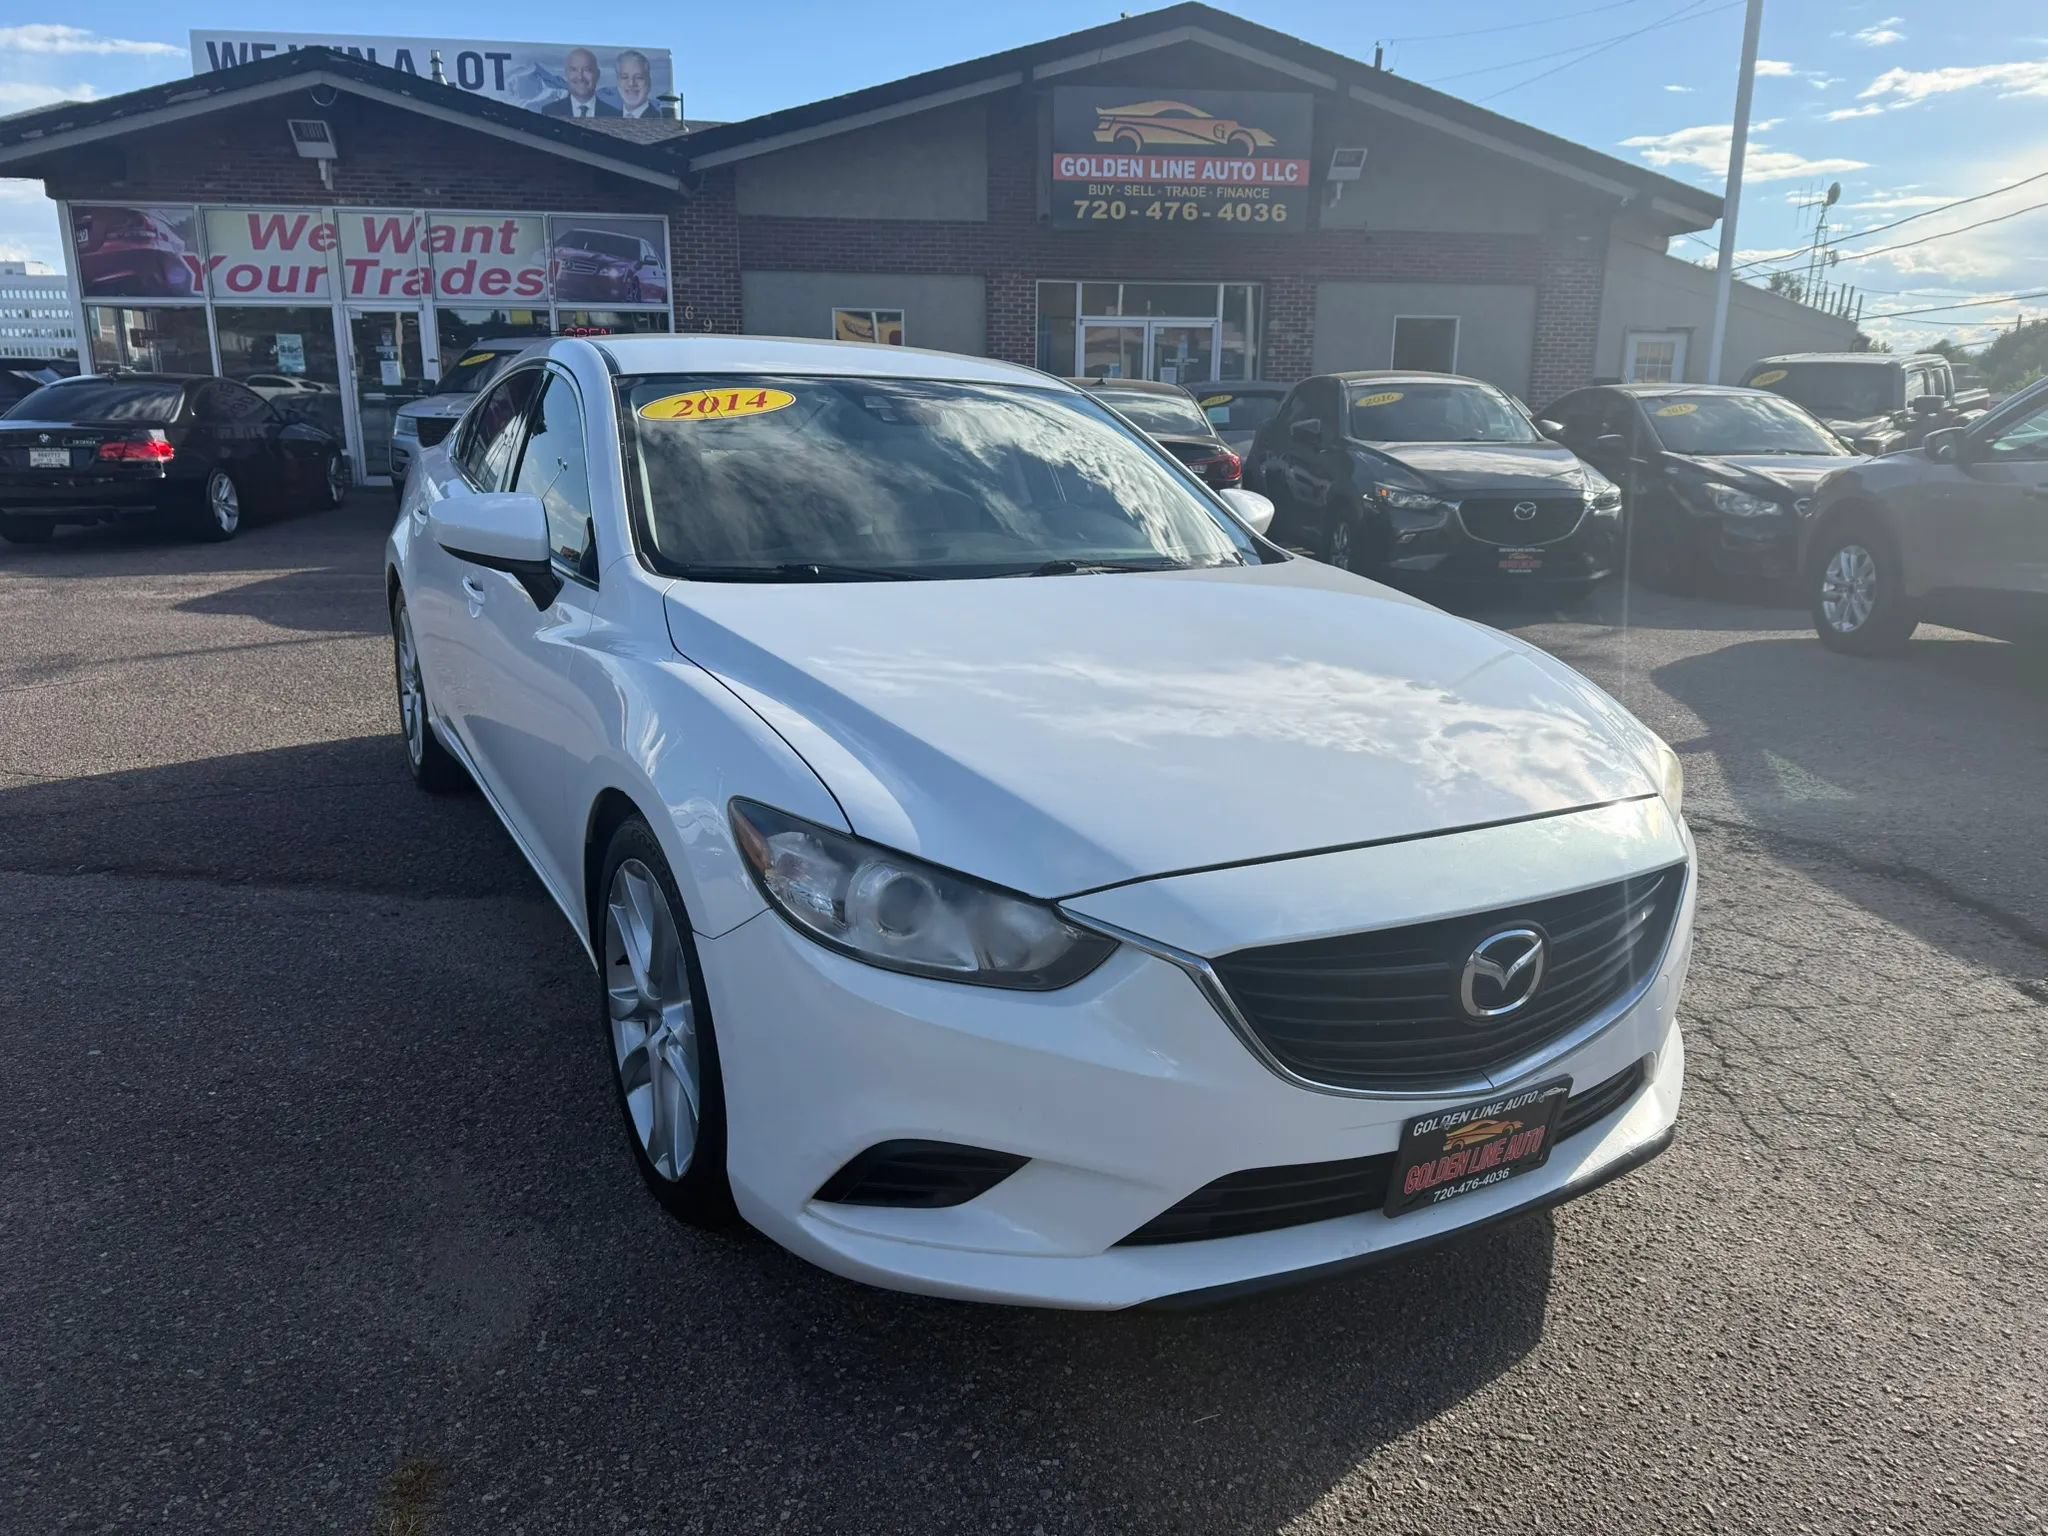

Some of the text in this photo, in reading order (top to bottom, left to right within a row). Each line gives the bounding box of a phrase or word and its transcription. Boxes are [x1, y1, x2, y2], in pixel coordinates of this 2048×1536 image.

[448, 50, 512, 91] OT
[1060, 157, 1299, 182] GOLDEN LINE AUTO LLC
[1088, 184, 1271, 199] BUY SELL TRADE FINANCE
[247, 213, 519, 255] We Want
[182, 254, 561, 296] Your Trades!
[671, 390, 768, 418] 2014
[1413, 1090, 1539, 1137] GOLDEN LINE AUTO
[1403, 1124, 1546, 1195] GOLDEN LINE AUTO
[1433, 1167, 1511, 1203] 720-476-4036
